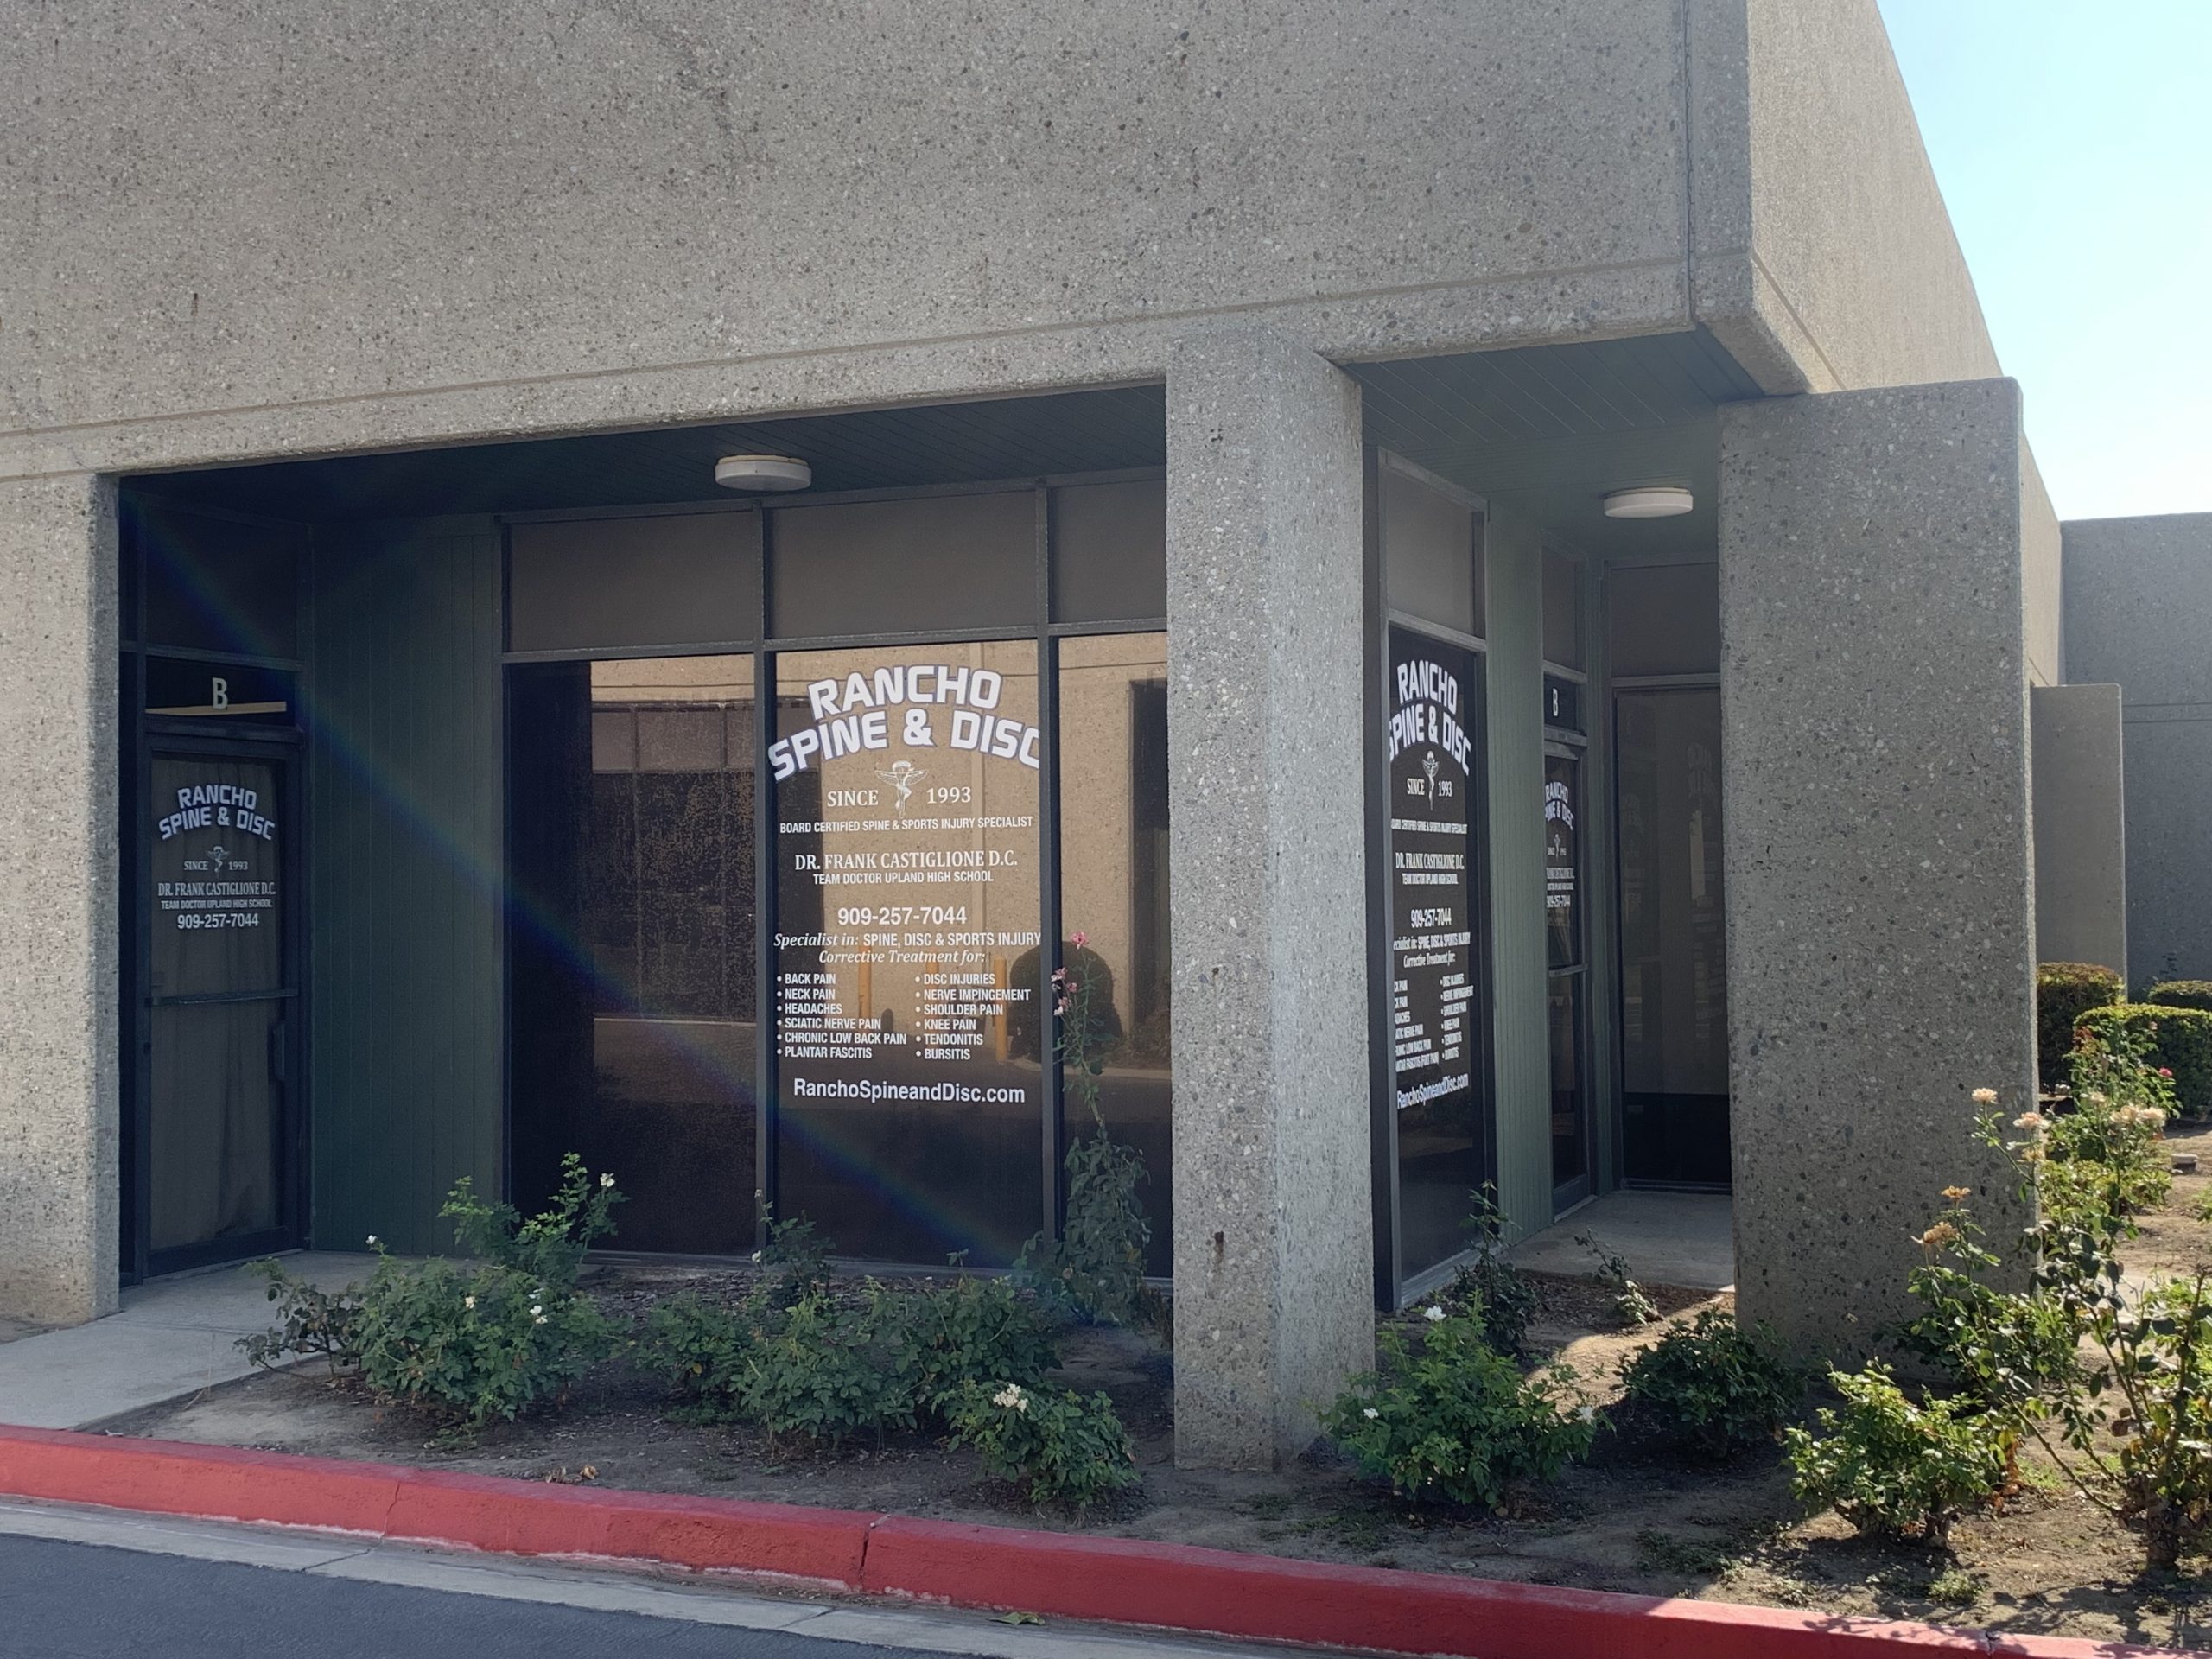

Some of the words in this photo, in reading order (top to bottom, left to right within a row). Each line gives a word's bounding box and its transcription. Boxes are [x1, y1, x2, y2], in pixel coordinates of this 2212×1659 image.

[212, 677, 228, 709] B
[808, 664, 1001, 721] RANCHO
[1397, 660, 1458, 715] RANCHO
[1553, 688, 1559, 717] B
[767, 710, 888, 781] SPINE
[903, 708, 935, 747] &
[950, 709, 1039, 770] DISC
[1428, 705, 1439, 744] &
[1443, 711, 1471, 776] DISC
[1407, 778, 1425, 795] SINCE
[1438, 780, 1452, 797] 1993
[177, 785, 257, 810] RANCHO
[827, 790, 879, 807] SINCE
[926, 786, 971, 804] 1993
[158, 806, 212, 840] SPINE
[217, 806, 230, 827] &
[236, 810, 276, 841] DISC
[779, 823, 811, 834] BOARD
[814, 821, 860, 833] CERTIFIED
[862, 820, 890, 831] SPINE
[892, 820, 899, 830] &
[901, 818, 938, 830] SPORTS
[941, 817, 975, 829] INJURY
[978, 816, 1033, 828] SPECIALIST
[183, 861, 208, 871] SINCE
[228, 861, 249, 871] 1993
[795, 855, 820, 870] DR.
[824, 853, 877, 869] FRANK
[880, 850, 985, 868] CASTIGLIONE
[988, 849, 1018, 866] D.C.
[813, 874, 840, 885] TEAM
[842, 873, 882, 884] DOCTOR
[885, 872, 924, 883] UPLAND
[927, 871, 950, 882] HIGH
[953, 871, 994, 882] SCHOOL
[158, 882, 174, 896] DR.
[175, 882, 205, 896] FRANK
[206, 882, 260, 895] CASTIGLIONE
[261, 882, 276, 895] D.C.
[177, 913, 258, 929] 909-257-7044
[837, 906, 967, 925] 909-257-7044
[1411, 907, 1452, 928] 909-257-7044
[773, 933, 837, 950] Specialist
[842, 933, 859, 946] in:
[863, 933, 900, 948] SPINE,
[904, 933, 931, 946] DISC
[935, 933, 944, 946] &
[947, 932, 995, 946] SPORTS
[998, 932, 1041, 946] INJURY
[818, 950, 885, 963] Corrective
[888, 950, 960, 963] Treatment
[959, 950, 985, 965] for:
[785, 973, 811, 984] BACK
[813, 973, 836, 984] PAIN
[924, 973, 947, 985] DISC
[950, 973, 995, 985] INJURIES
[785, 988, 811, 1000] NECK
[812, 988, 836, 1000] PAIN
[924, 988, 957, 1001] NERVE
[959, 988, 1031, 1001] IMPINGEMENT
[785, 1003, 842, 1014] HEADACHES
[924, 1003, 977, 1015] SHOULDER
[979, 1003, 1003, 1015] PAIN
[785, 1017, 822, 1028] SCIATIC
[824, 1018, 856, 1029] NERVE
[858, 1018, 881, 1029] PAIN
[924, 1019, 950, 1030] KNEE
[952, 1019, 976, 1031] PAIN
[785, 1032, 828, 1043] CHRONIC
[830, 1033, 851, 1044] LOW
[855, 1033, 881, 1044] BACK
[883, 1033, 907, 1045] PAIN
[924, 1033, 983, 1046] TENDONITIS
[785, 1046, 828, 1058] PLANTAR
[830, 1047, 872, 1058] FASCITIS
[925, 1048, 971, 1060] BURSITIS
[793, 1077, 1026, 1103] RanchoSpineandDisc.com
[1396, 1073, 1468, 1109] RanchoSpineandDisc.com
